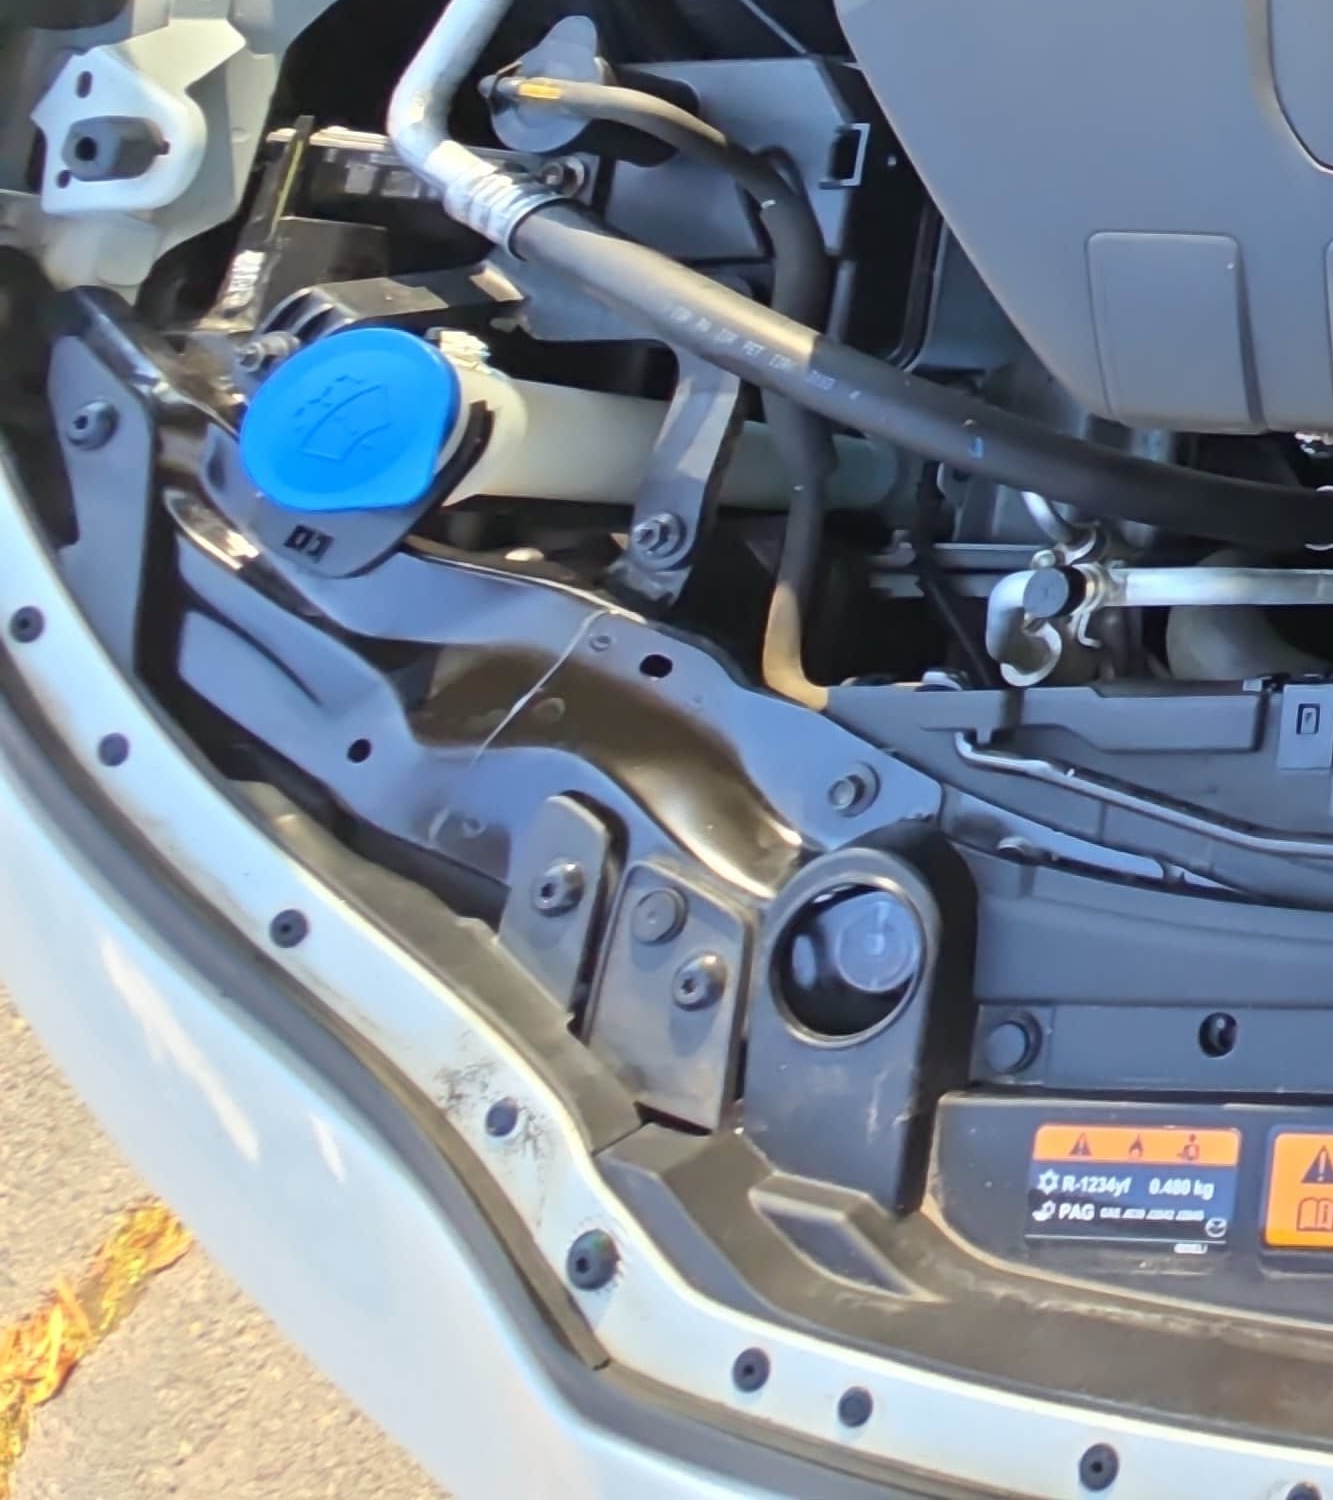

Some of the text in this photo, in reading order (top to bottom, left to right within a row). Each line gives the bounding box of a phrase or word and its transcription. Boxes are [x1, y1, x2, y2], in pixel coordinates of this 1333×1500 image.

[1061, 1174, 1133, 1198] R-1234yf
[1193, 1178, 1215, 1200] kg
[1058, 1203, 1096, 1221] PAG
